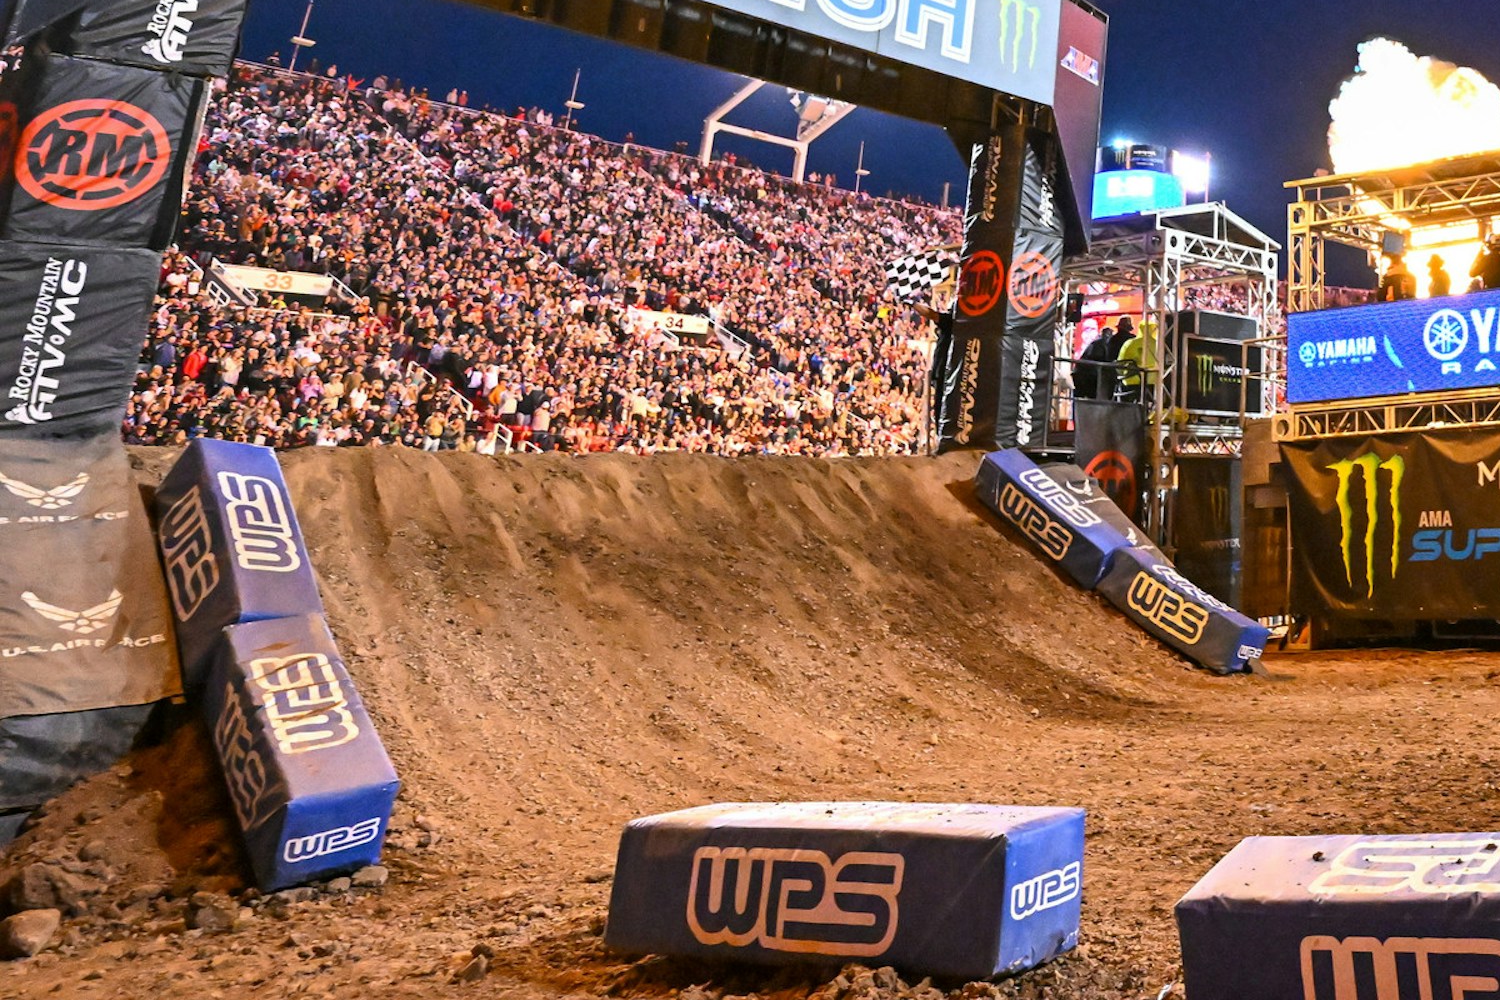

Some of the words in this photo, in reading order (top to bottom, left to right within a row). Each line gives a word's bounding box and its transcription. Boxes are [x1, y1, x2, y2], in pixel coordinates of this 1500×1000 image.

[23, 257, 63, 346] MOUNTAIN
[264, 274, 293, 290] 33
[665, 316, 684, 329] 34
[1316, 336, 1377, 359] YAMAHA
[9, 346, 40, 401] ROCKY
[1213, 364, 1250, 376] MONSTR
[216, 471, 300, 572] WPS
[999, 483, 1074, 561] WPS
[1019, 468, 1103, 528] WPS
[1419, 510, 1453, 528] AMA
[1127, 571, 1209, 645] WPS
[51, 639, 90, 652] AIR
[1237, 645, 1263, 660] WPS
[284, 816, 382, 863] WPS
[686, 846, 905, 958] WPS
[1010, 860, 1080, 921] WPS
